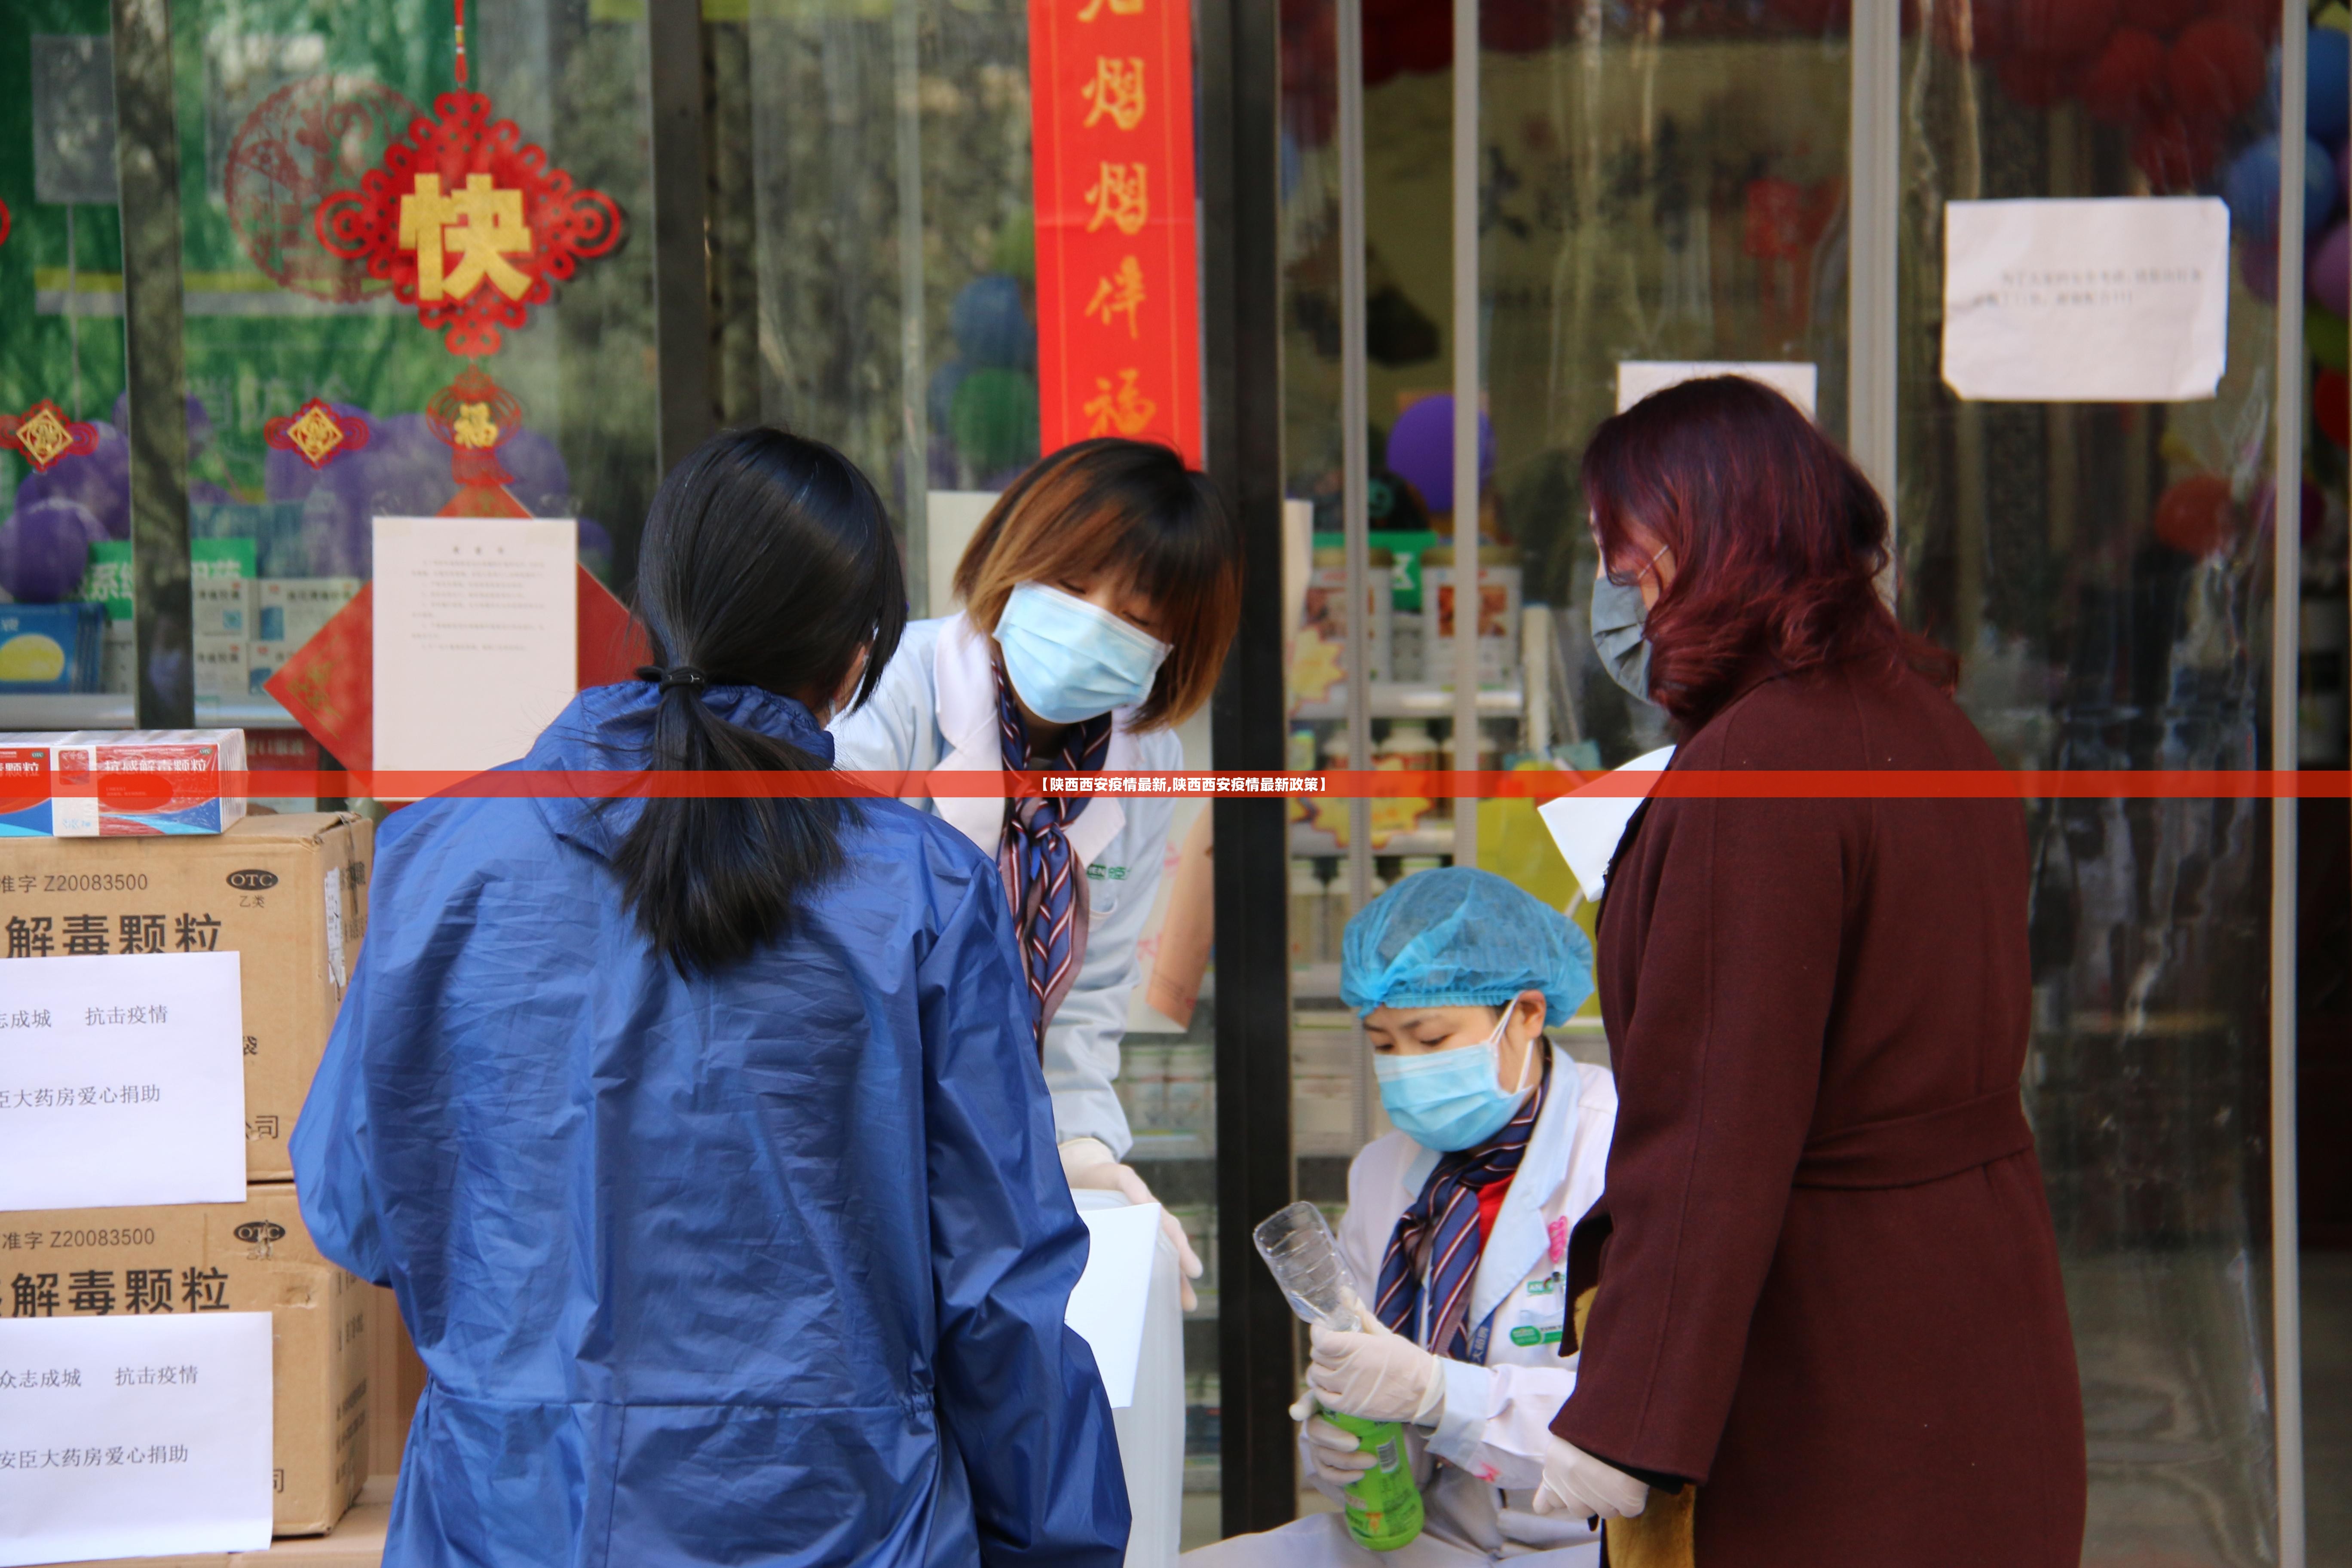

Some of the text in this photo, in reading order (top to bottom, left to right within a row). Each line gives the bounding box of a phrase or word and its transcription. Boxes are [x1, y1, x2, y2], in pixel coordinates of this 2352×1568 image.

[399, 173, 532, 301] 快
[0, 762, 40, 777] 颗粒
[104, 759, 208, 775] 抗感解毒颗粒
[0, 874, 148, 893] 准字 Z20083500
[230, 874, 273, 886] OTC
[239, 895, 265, 908] 乙类
[6, 913, 221, 958] 解毒颗粒
[85, 1004, 168, 1026] 抗击疫情
[0, 1084, 160, 1109] 臣大药房爱心捐助
[2, 1228, 155, 1250] 准字 Z20083500
[11, 1267, 230, 1317] 解毒颗粒
[0, 1365, 198, 1389] 众志成城 抗击疫情
[0, 1444, 188, 1469] 安臣大药房爱心捐助
